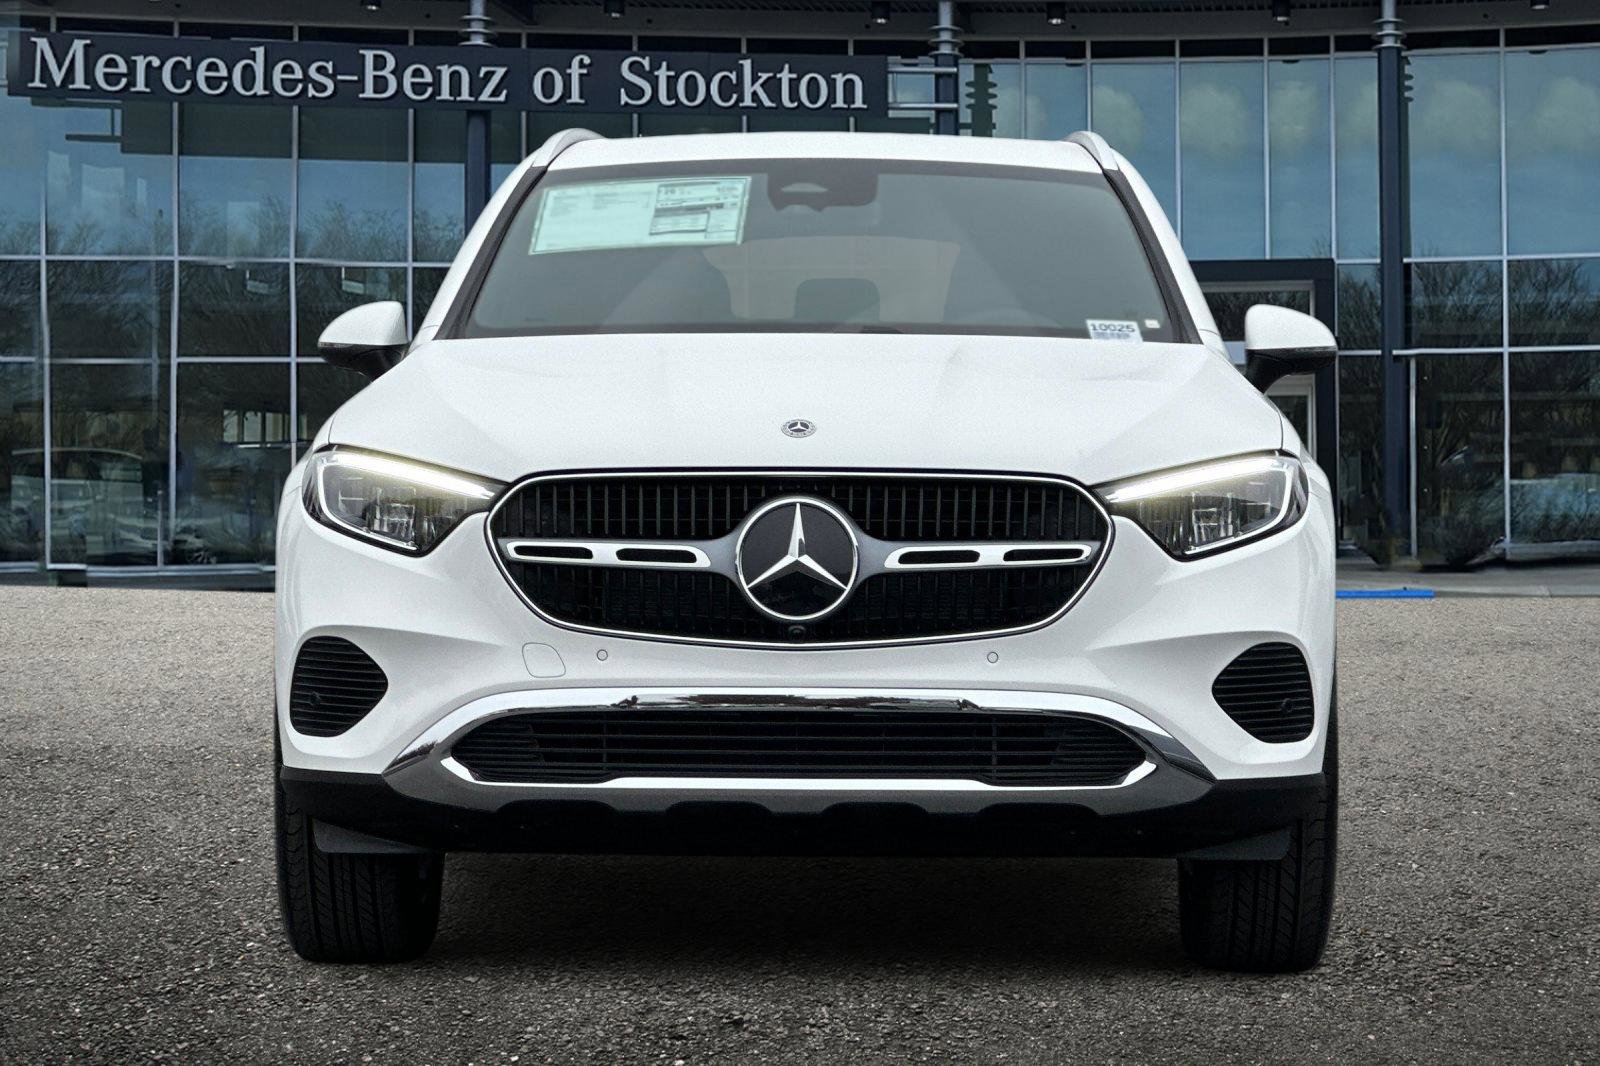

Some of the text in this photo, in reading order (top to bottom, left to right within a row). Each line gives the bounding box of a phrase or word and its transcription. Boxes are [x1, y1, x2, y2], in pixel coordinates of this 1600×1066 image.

[27, 36, 868, 110] Mercedes-Benz of Stockton
[1090, 323, 1136, 333] 10025
